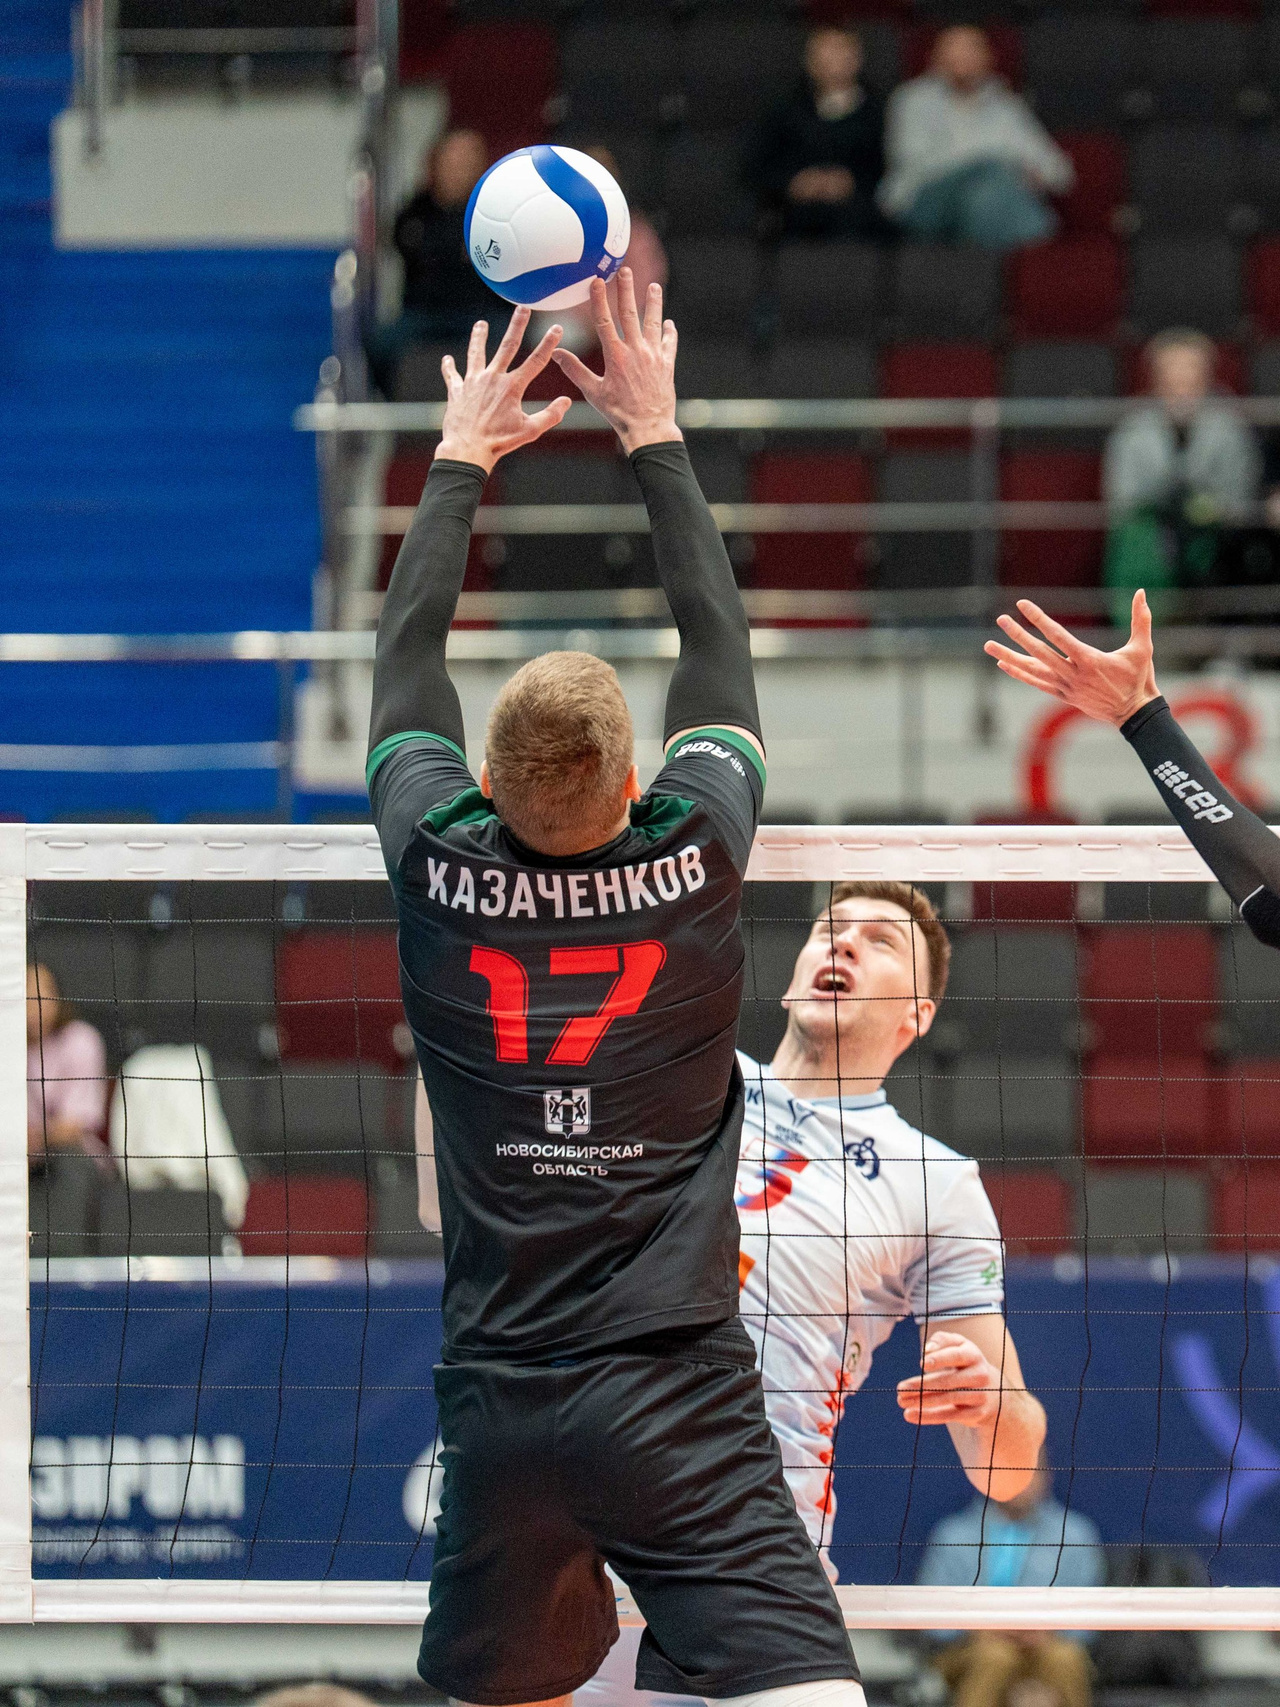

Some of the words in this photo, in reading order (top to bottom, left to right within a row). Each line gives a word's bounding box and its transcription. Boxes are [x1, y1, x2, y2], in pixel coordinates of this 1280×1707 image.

[1173, 780, 1234, 823] cep
[427, 845, 706, 918] КАЗАЧЕНКОВ
[469, 939, 667, 1067] 17
[496, 1143, 644, 1159] НОВОСИБИРСКАЯ
[532, 1162, 609, 1177] ОБЛАСТЬ
